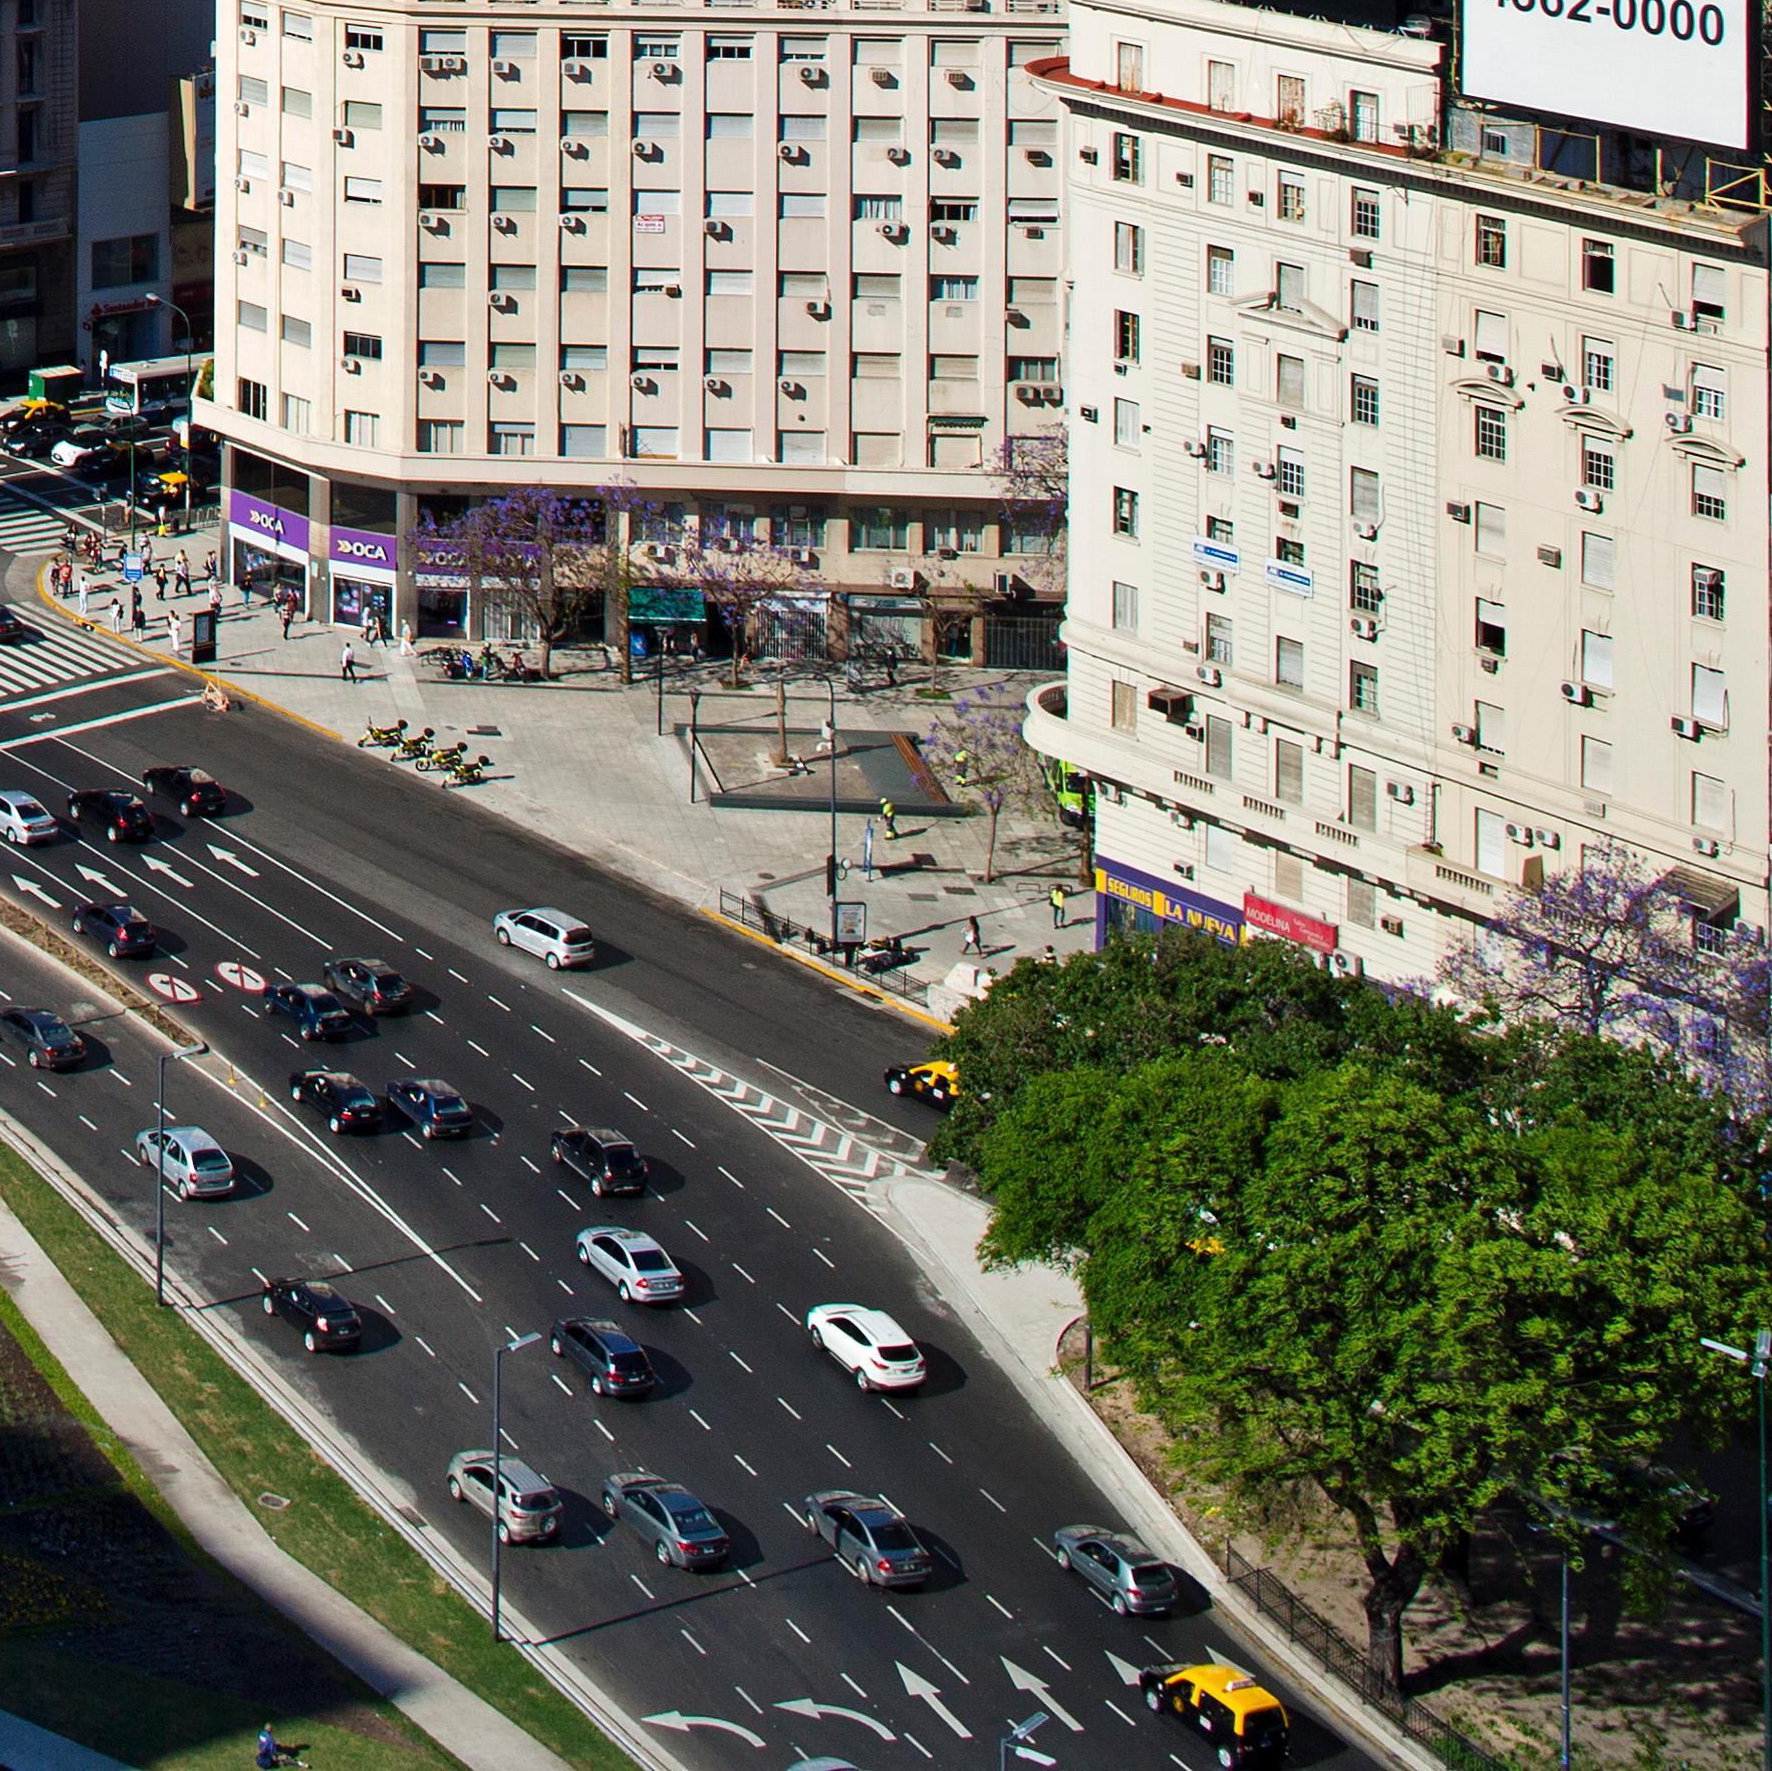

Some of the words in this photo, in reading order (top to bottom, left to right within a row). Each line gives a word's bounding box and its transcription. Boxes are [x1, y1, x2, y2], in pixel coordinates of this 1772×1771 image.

[260, 513, 285, 535] OCA
[352, 542, 387, 561] OCA
[1107, 877, 1153, 907] SEGUROS
[1165, 899, 1183, 922] LA
[1186, 908, 1236, 942] NUEVA
[1245, 906, 1291, 933] MODELINA
